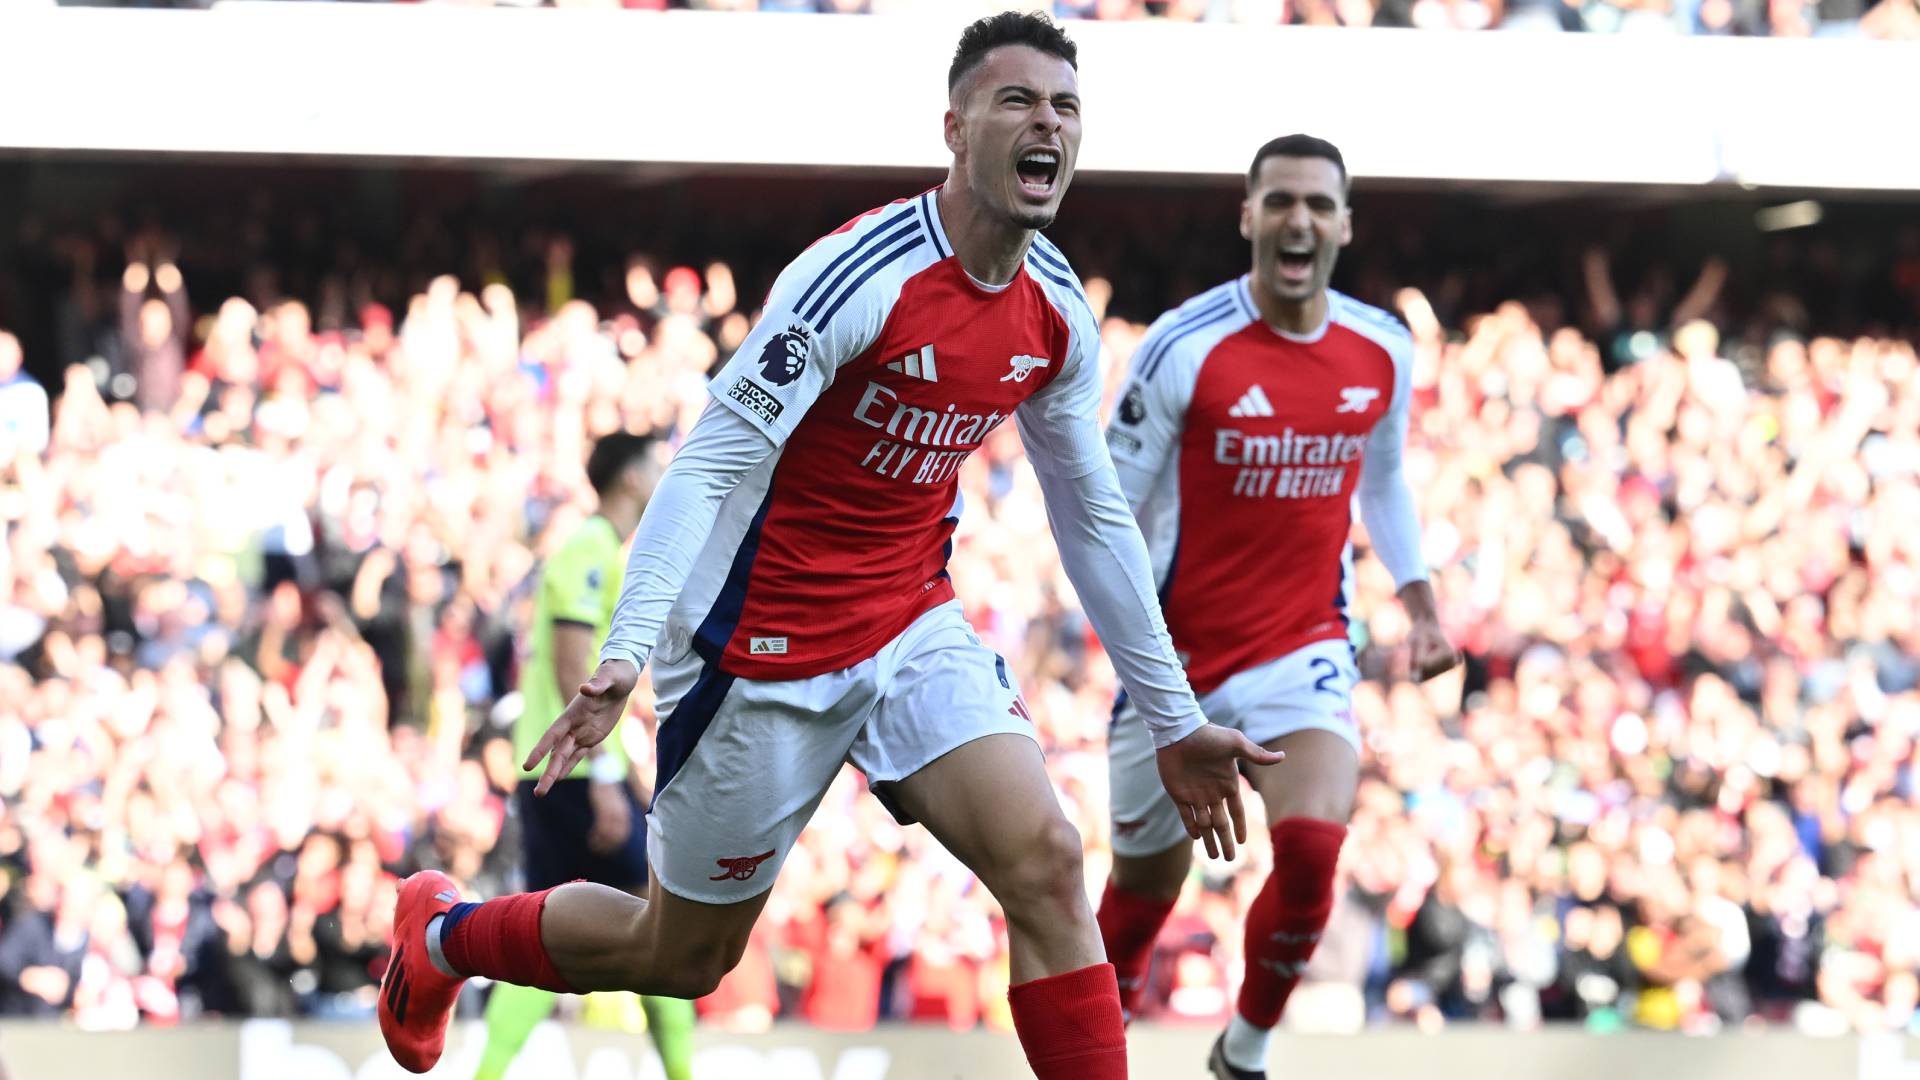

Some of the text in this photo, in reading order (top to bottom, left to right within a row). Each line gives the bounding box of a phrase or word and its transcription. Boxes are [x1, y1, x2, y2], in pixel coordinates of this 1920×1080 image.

[747, 385, 779, 414] room
[860, 439, 918, 479] FLY
[1233, 468, 1275, 498] FLY
